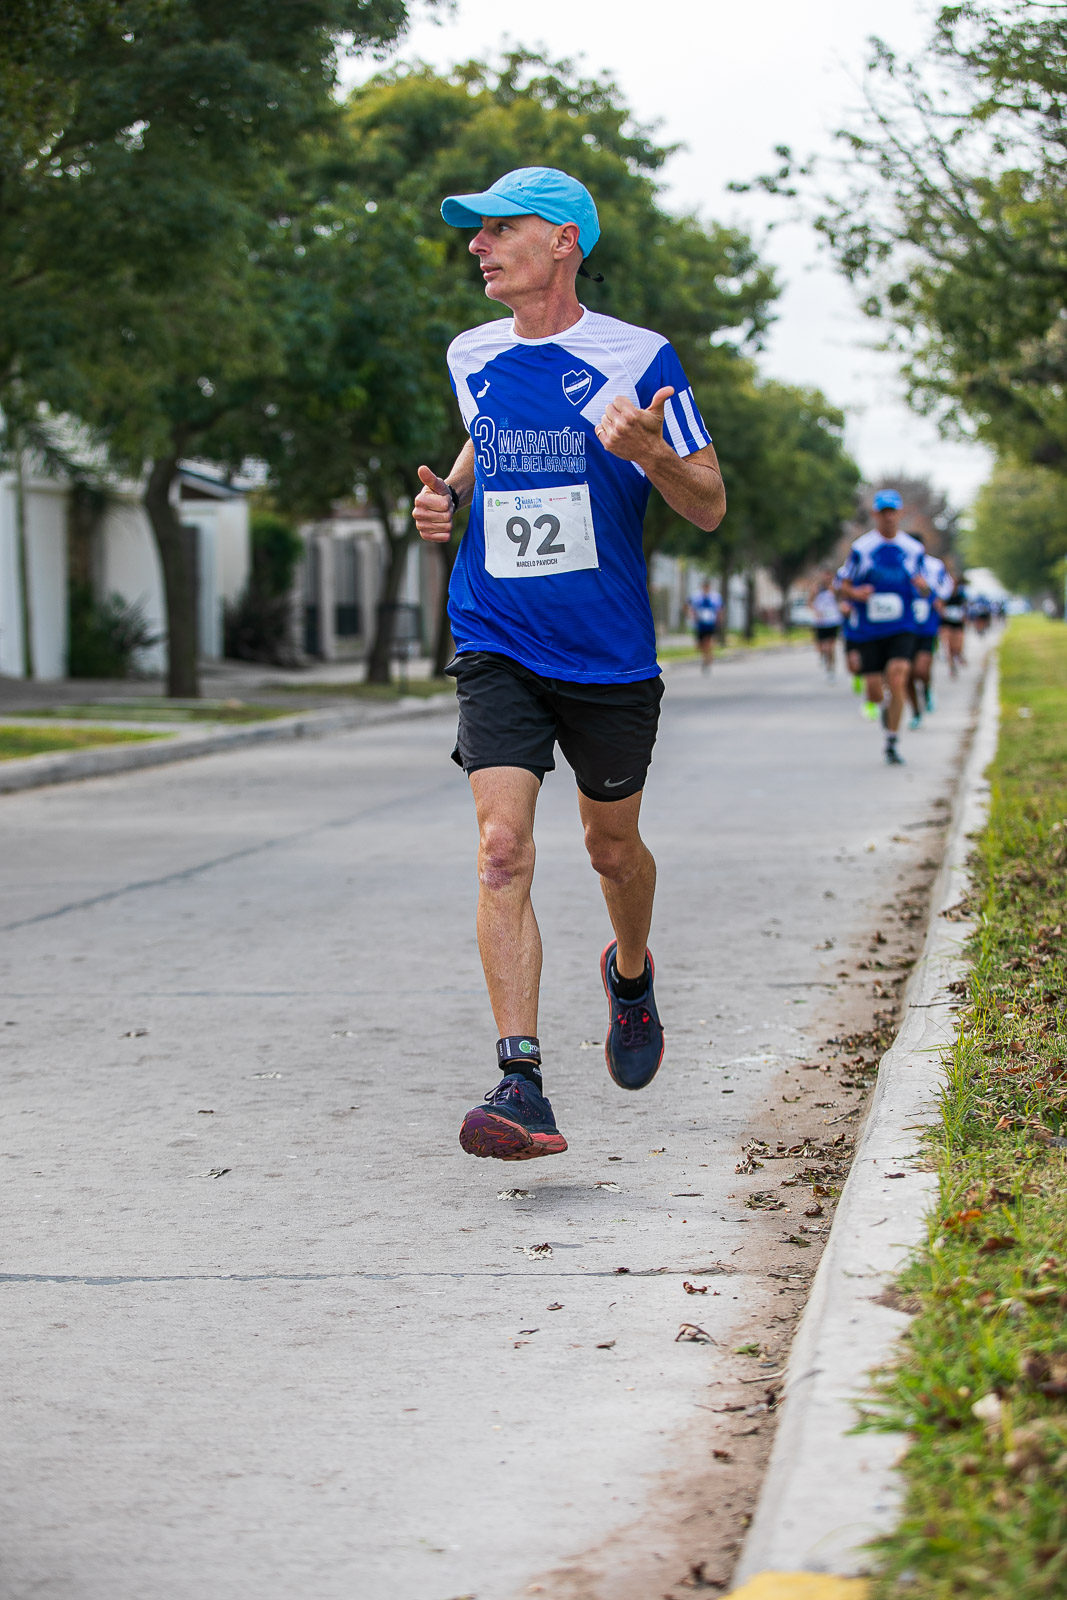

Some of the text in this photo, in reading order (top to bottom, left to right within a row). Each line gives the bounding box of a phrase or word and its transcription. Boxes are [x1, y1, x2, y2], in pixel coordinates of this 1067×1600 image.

[474, 415, 497, 477] 3
[498, 426, 586, 456] MARATÓN
[514, 496, 522, 511] 3
[505, 513, 566, 557] 92
[516, 559, 536, 568] MARCELO
